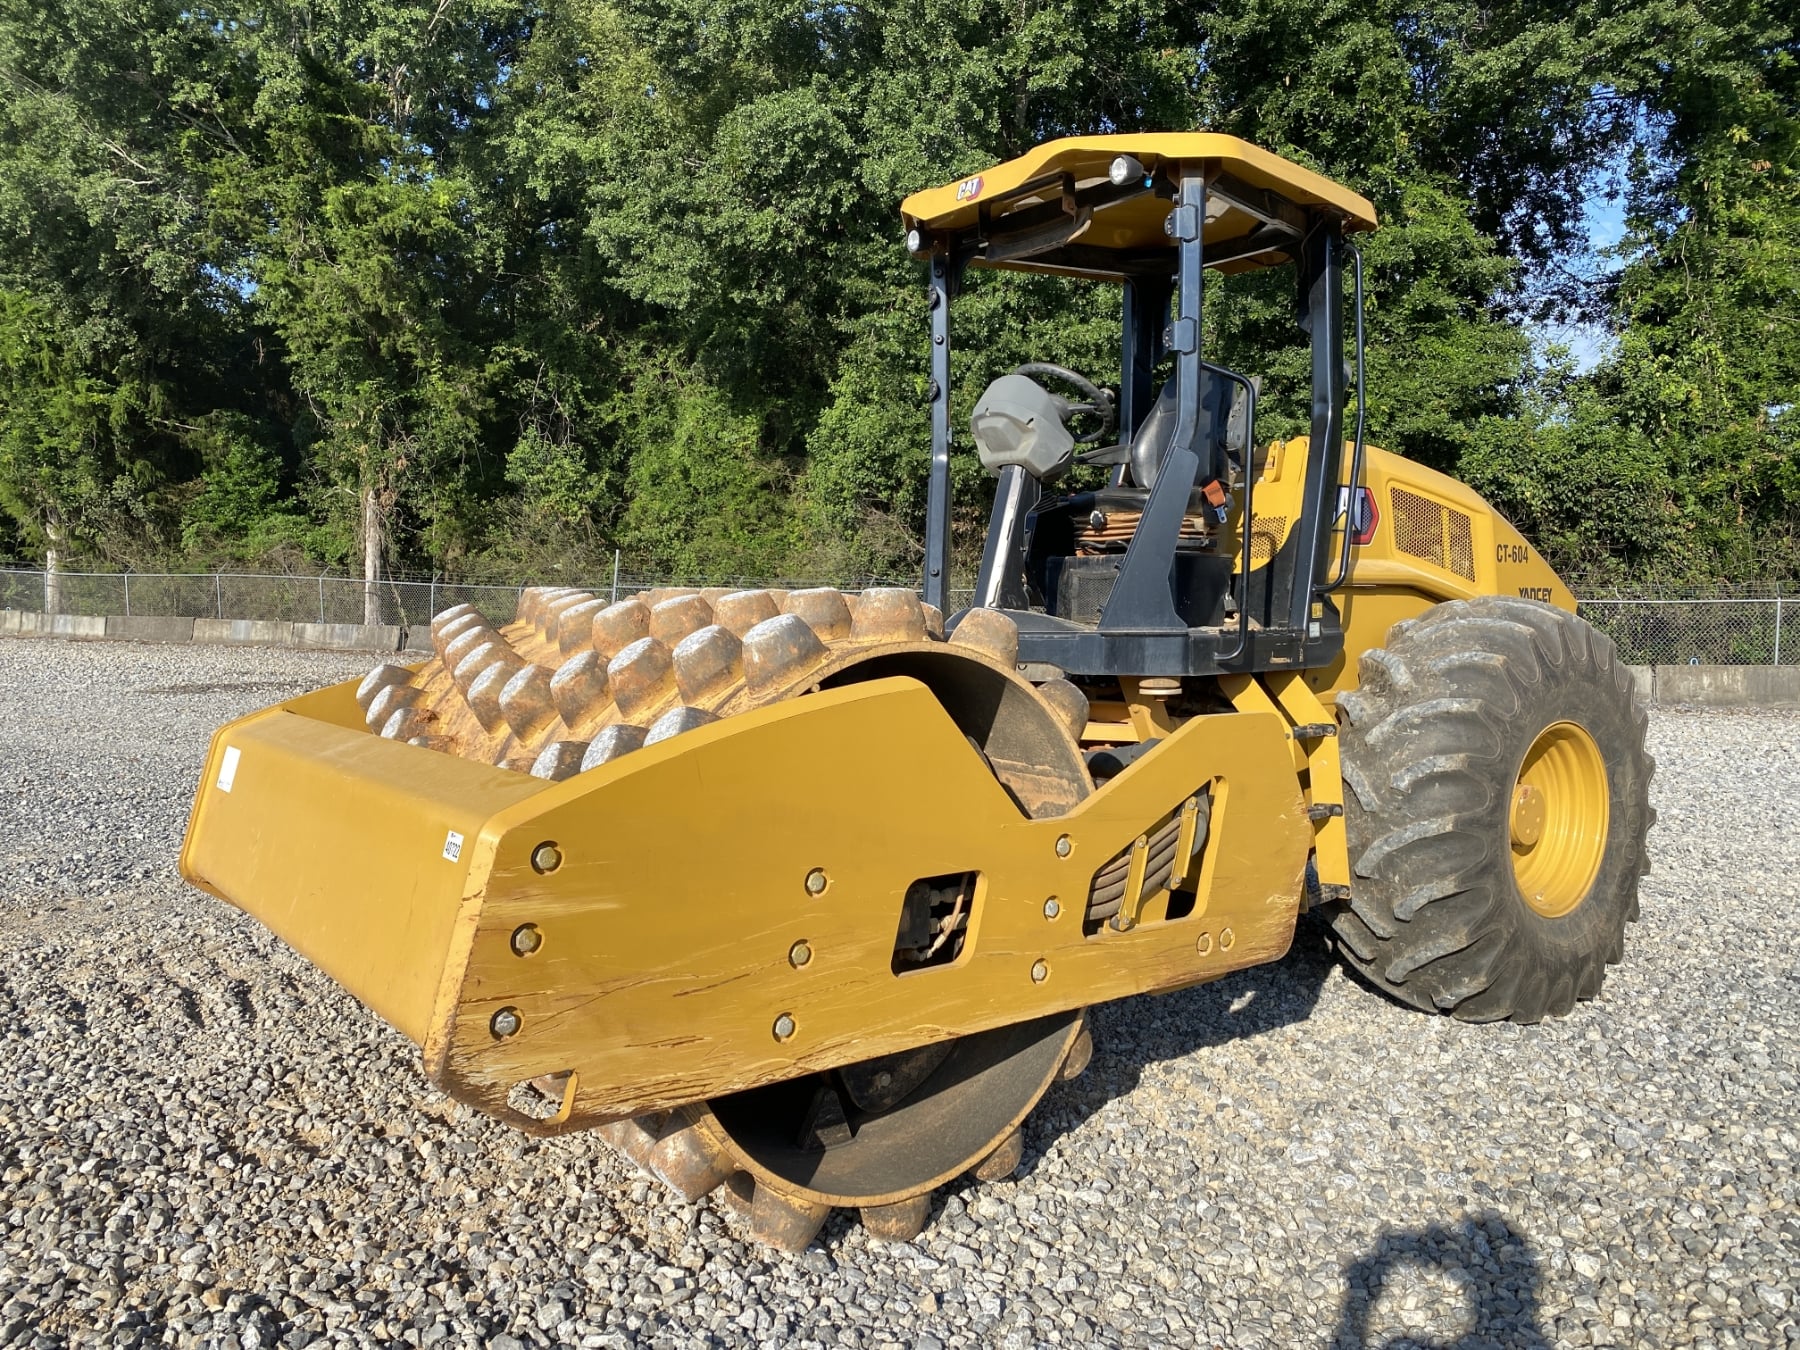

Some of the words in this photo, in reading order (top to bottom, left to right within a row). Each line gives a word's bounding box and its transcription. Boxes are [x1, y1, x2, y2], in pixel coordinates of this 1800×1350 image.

[957, 177, 980, 201] CAT
[1496, 543, 1529, 564] CT-604
[1518, 587, 1553, 604] YANCEY
